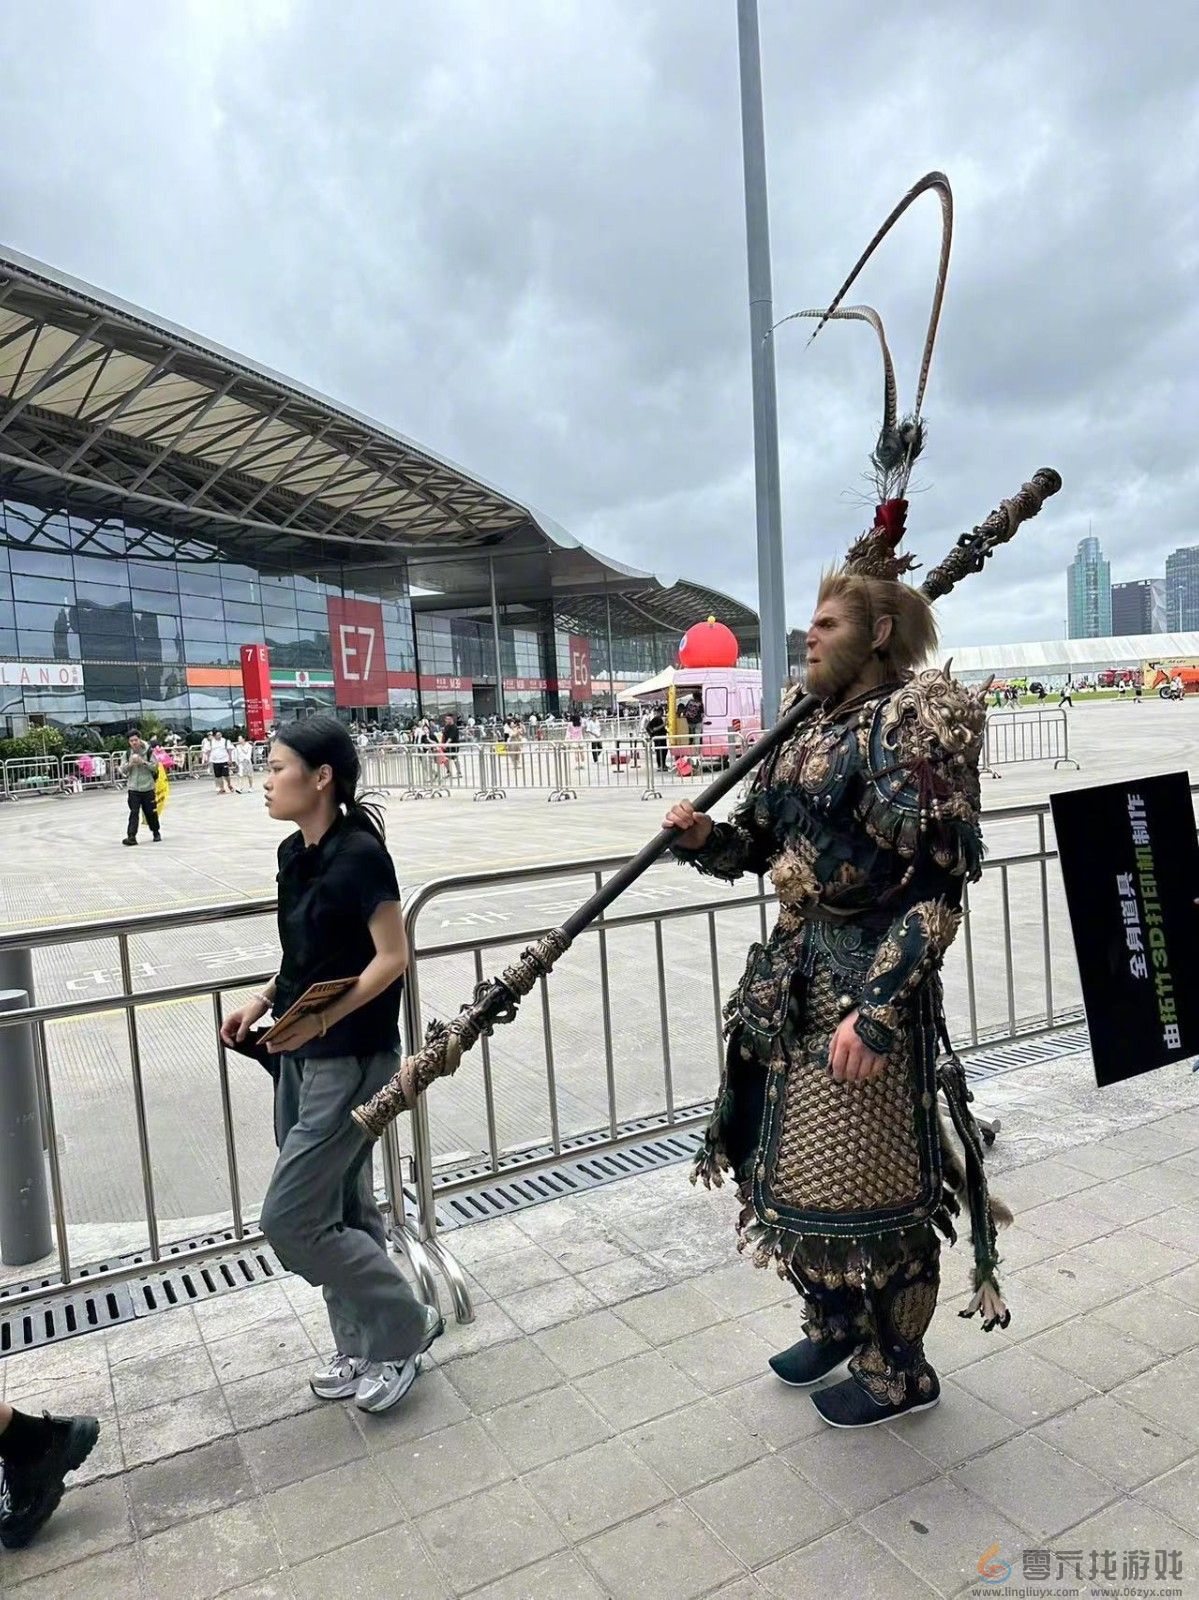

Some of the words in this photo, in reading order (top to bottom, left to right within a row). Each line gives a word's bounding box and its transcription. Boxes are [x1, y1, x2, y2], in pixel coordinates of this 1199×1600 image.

[245, 649, 254, 662] 7
[260, 648, 267, 661] E
[339, 625, 376, 681] E7
[573, 651, 588, 686] E6
[1, 667, 70, 684] LANO
[1117, 872, 1149, 979] 全身道具
[1127, 793, 1182, 1050] 由拓竹3D打印机制作
